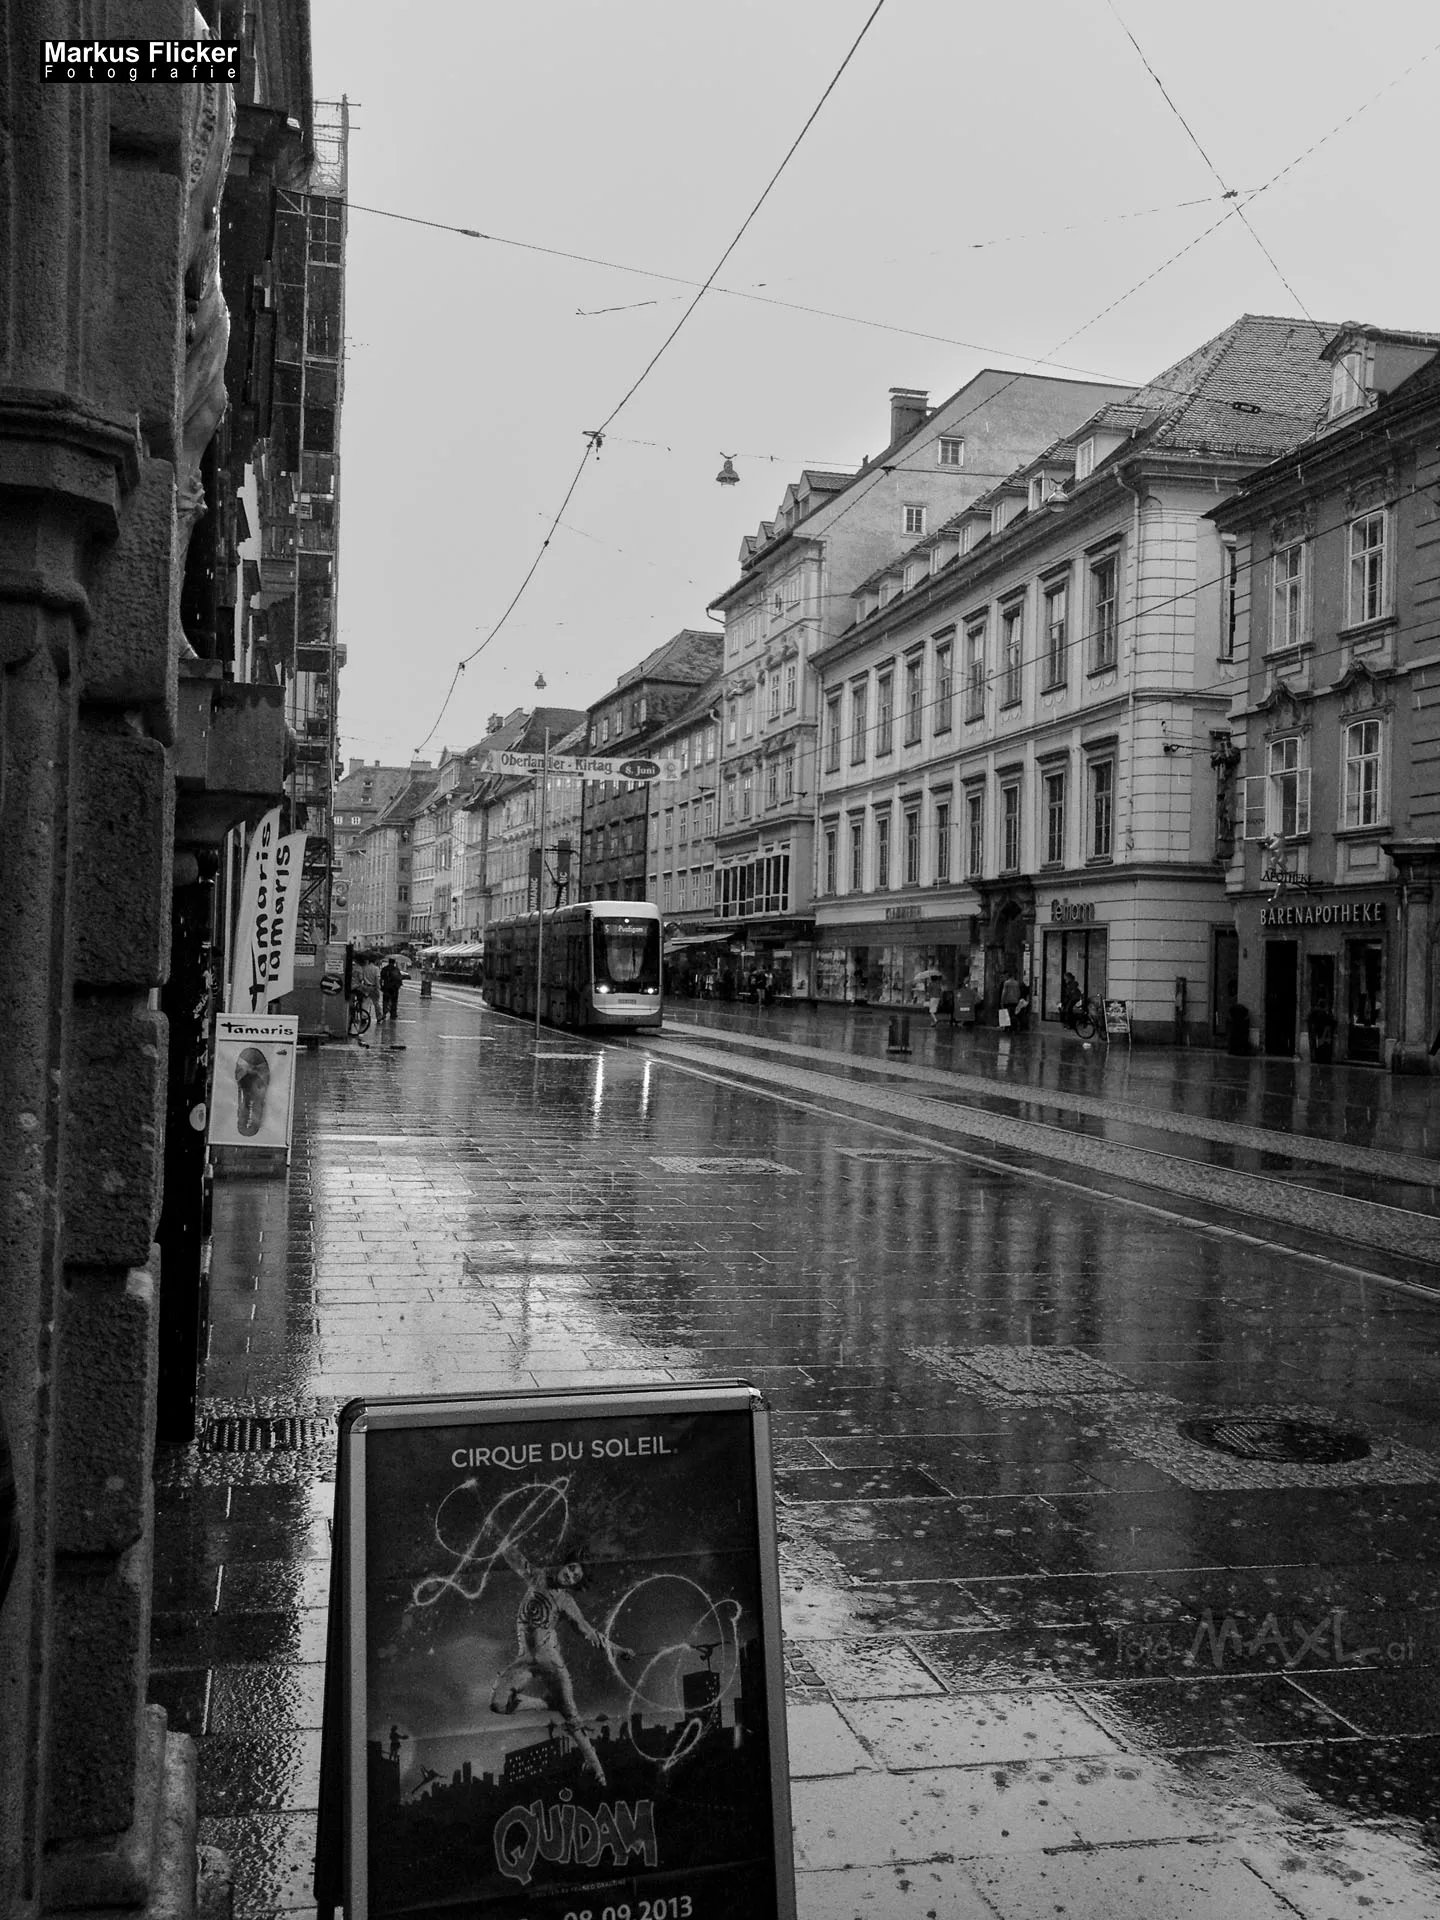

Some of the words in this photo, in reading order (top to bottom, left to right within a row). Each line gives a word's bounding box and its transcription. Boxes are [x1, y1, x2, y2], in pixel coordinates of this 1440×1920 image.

[576, 758, 613, 775] Kirtag
[637, 765, 656, 777] Juni
[249, 822, 271, 1013] tamaris
[220, 1022, 294, 1036] tamaris
[451, 1443, 543, 1471] CIRQUE
[551, 1441, 583, 1461] DU
[563, 1895, 693, 1920] 09.2013
